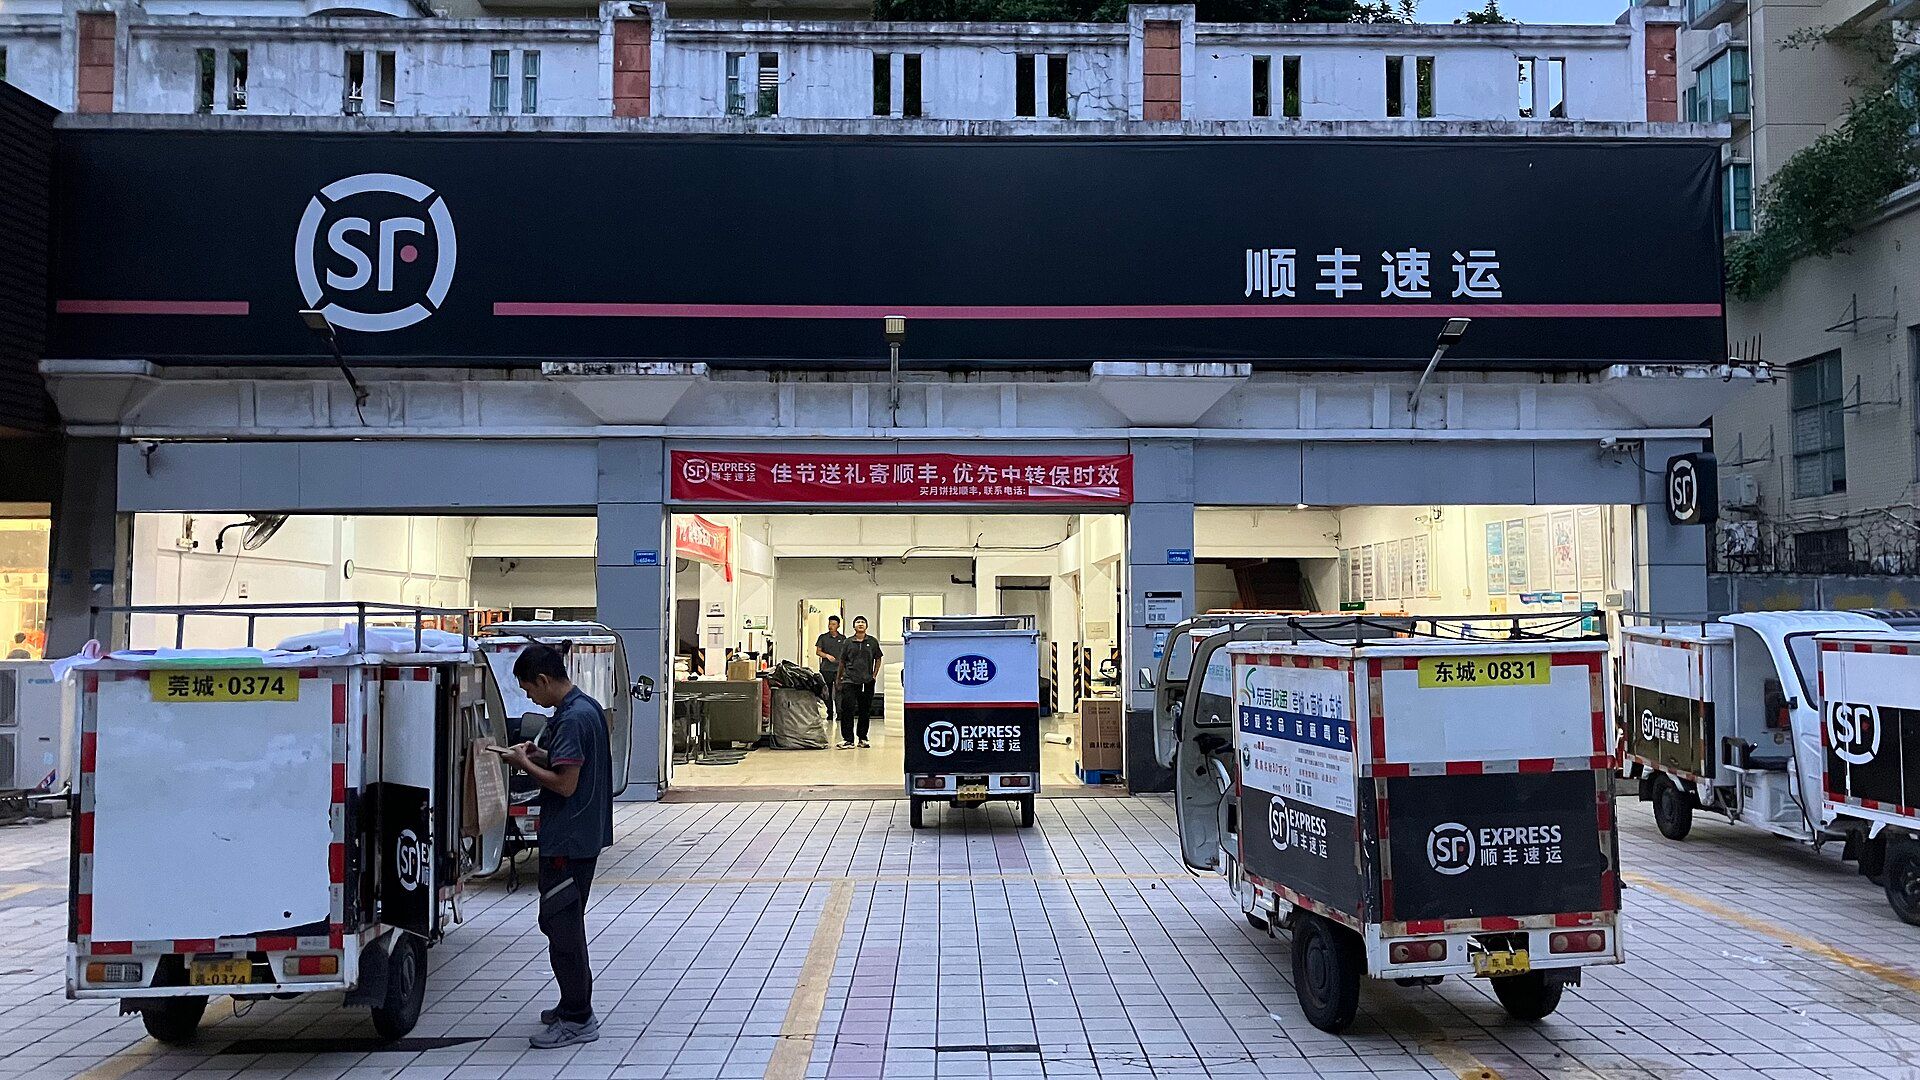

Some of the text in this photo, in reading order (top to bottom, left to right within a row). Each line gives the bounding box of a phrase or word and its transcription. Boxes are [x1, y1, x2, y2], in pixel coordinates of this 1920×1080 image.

[1245, 247, 1502, 298] 顺丰速运
[711, 462, 756, 472] EXPRESS
[711, 472, 756, 482] 顺丰速运
[955, 659, 989, 681] 快递
[1435, 661, 1536, 682] 东城·0831
[168, 675, 285, 697] 莞城·0374
[961, 725, 1021, 738] EXPRESS
[961, 739, 1021, 752] 顺丰速运
[1289, 808, 1327, 837] EXPRESS
[1479, 825, 1562, 846] EXPRESS
[1480, 846, 1563, 867] 顺丰速运
